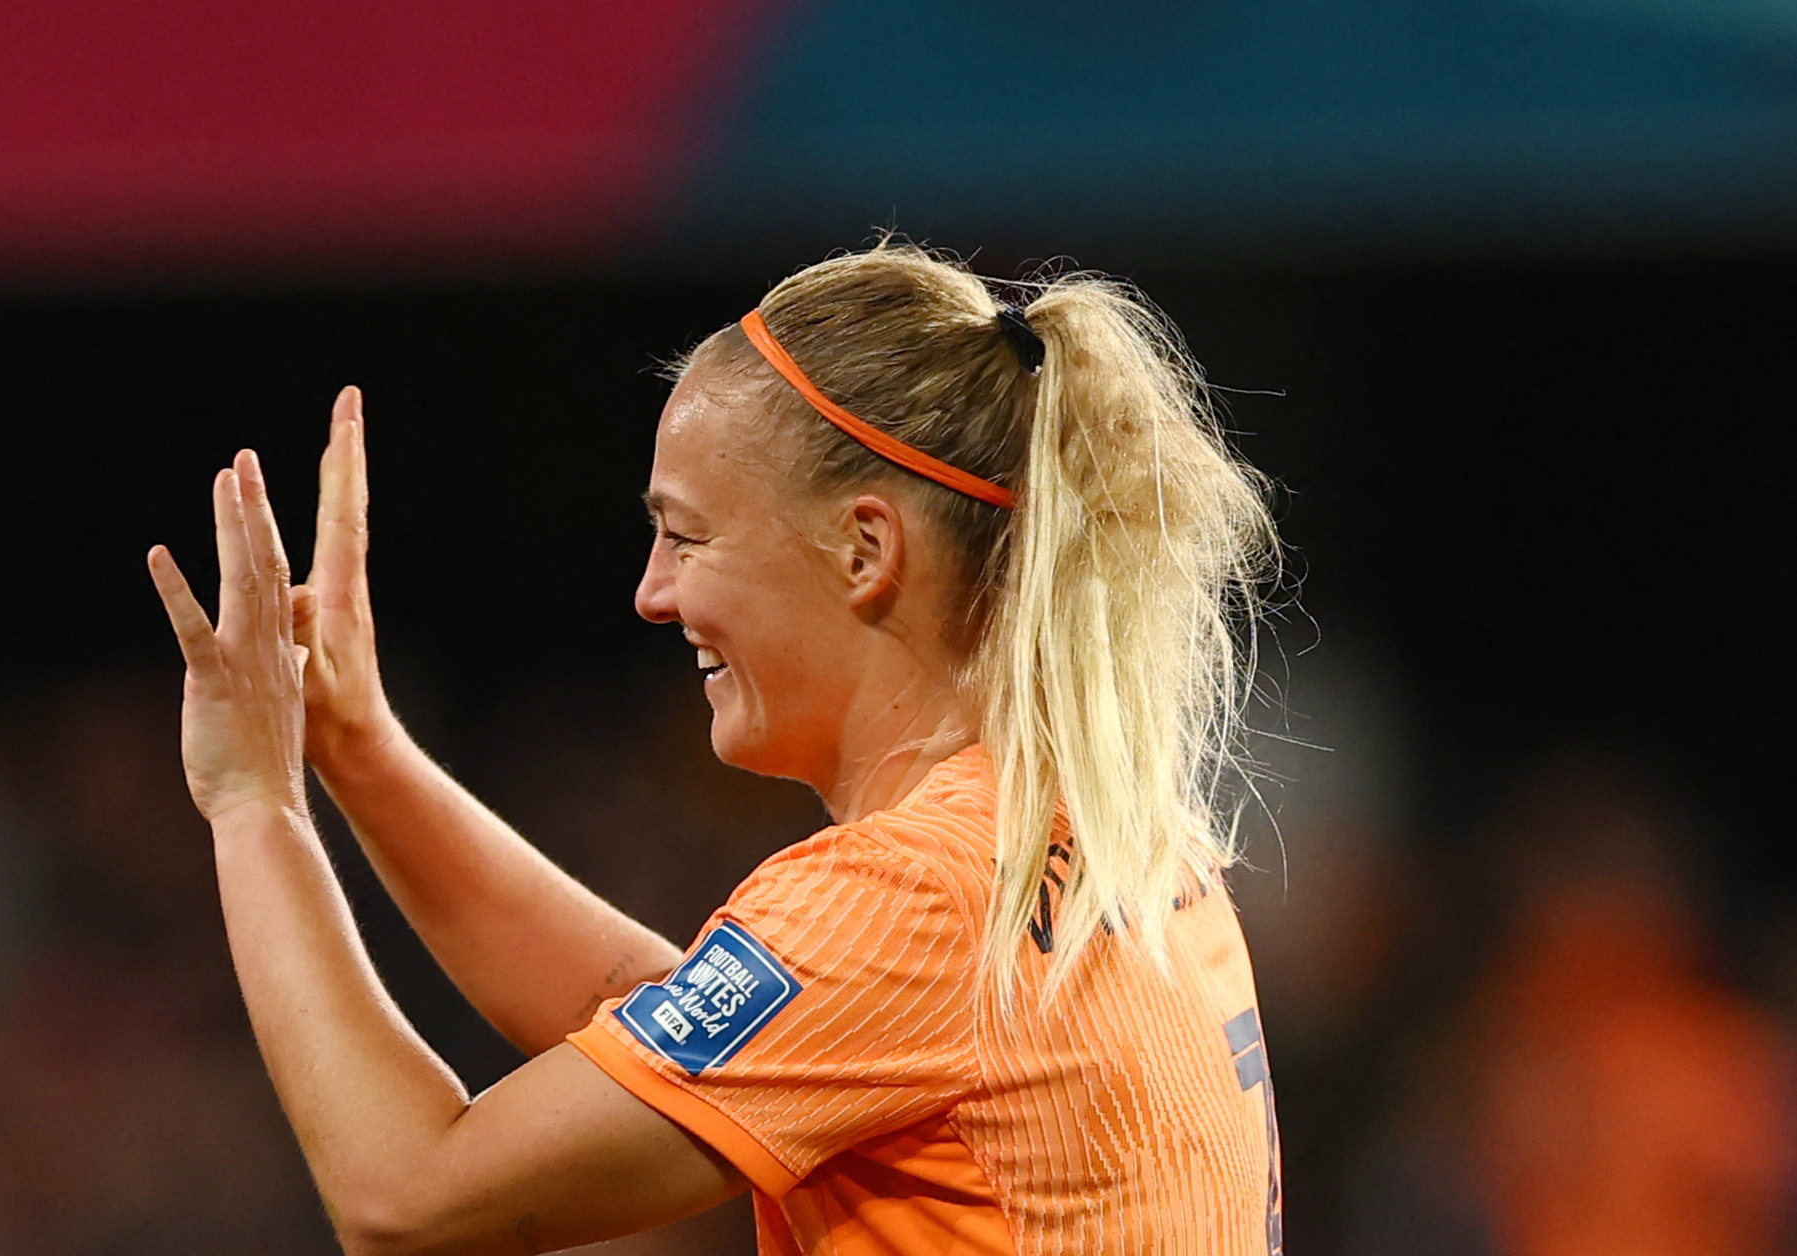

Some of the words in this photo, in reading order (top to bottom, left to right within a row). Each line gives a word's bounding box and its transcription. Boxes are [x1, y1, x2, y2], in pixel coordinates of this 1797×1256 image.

[704, 944, 759, 998] FOOTBALL
[659, 1008, 683, 1035] FIFA
[678, 987, 729, 1039] World
